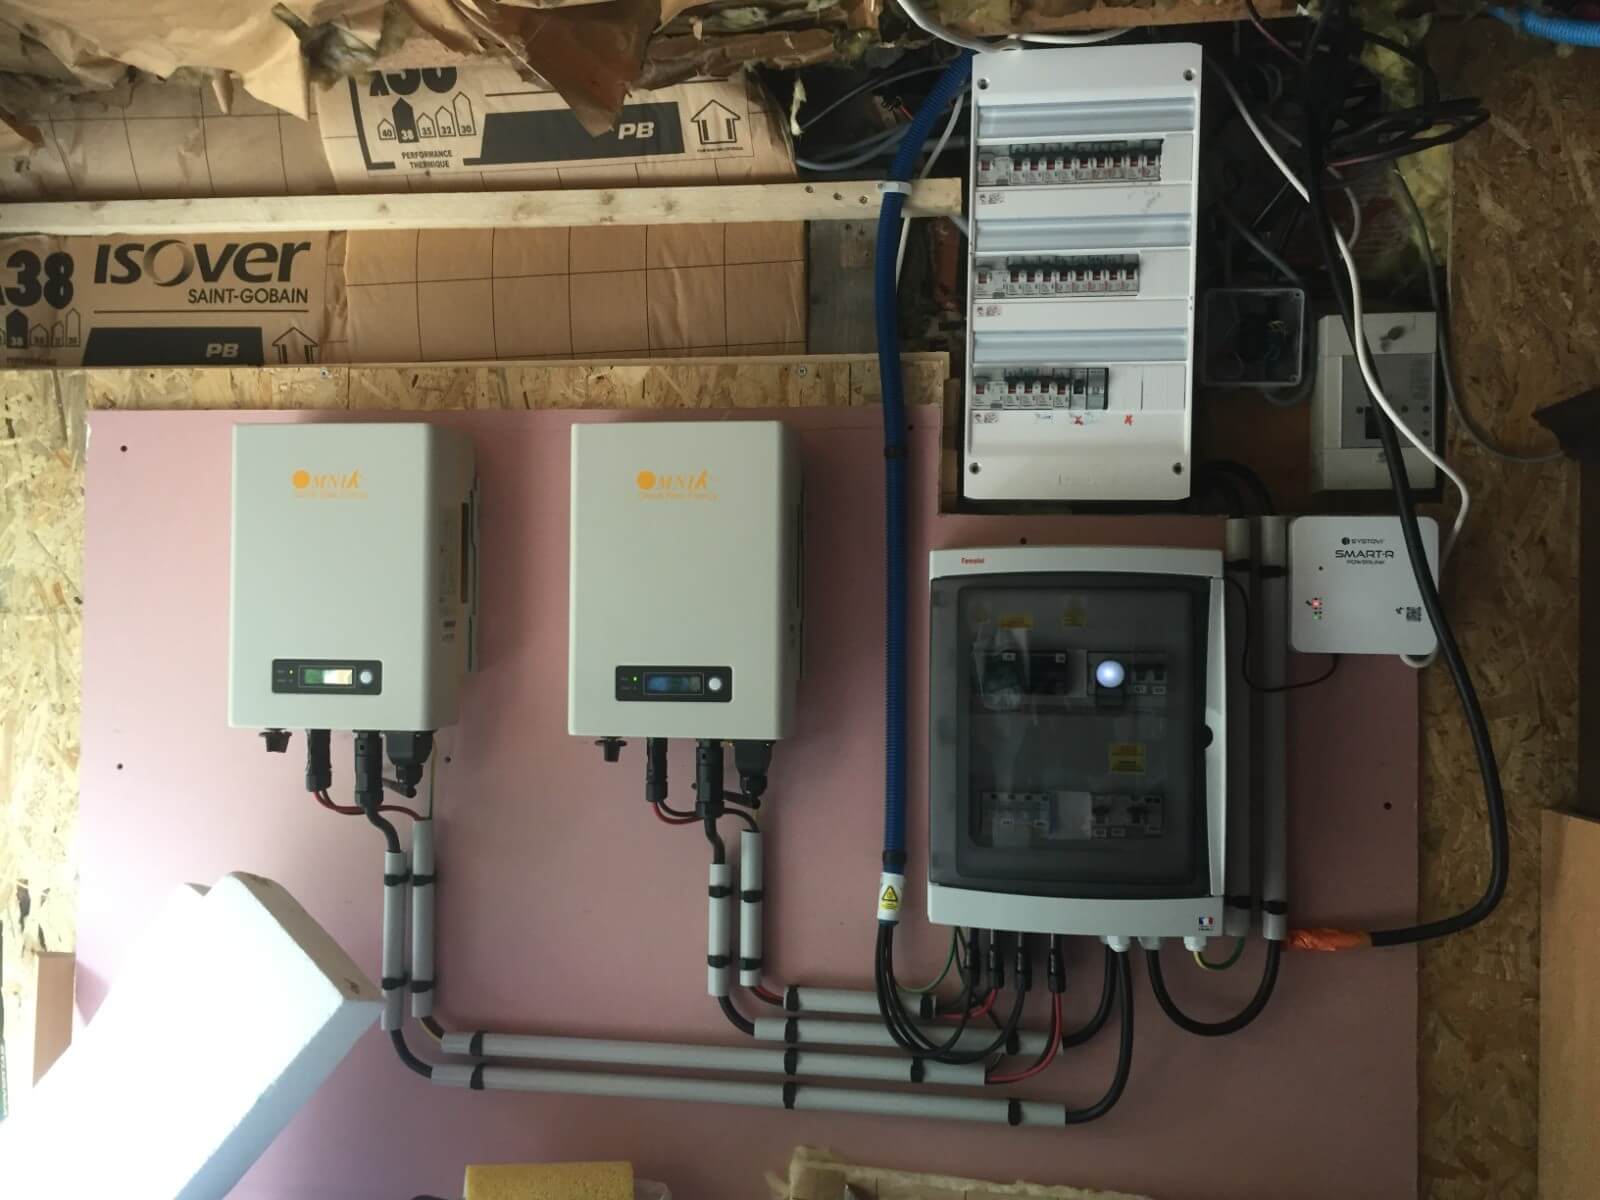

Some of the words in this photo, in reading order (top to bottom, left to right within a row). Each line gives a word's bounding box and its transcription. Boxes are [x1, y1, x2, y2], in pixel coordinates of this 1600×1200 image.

[400, 129, 414, 140] 38
[617, 120, 655, 140] PB
[401, 149, 453, 160] PERFORMANCE
[409, 159, 450, 169] THERMIQUE
[0, 249, 75, 309] 38
[188, 288, 308, 305] SAINT-GOBAIN
[205, 343, 239, 358] PB
